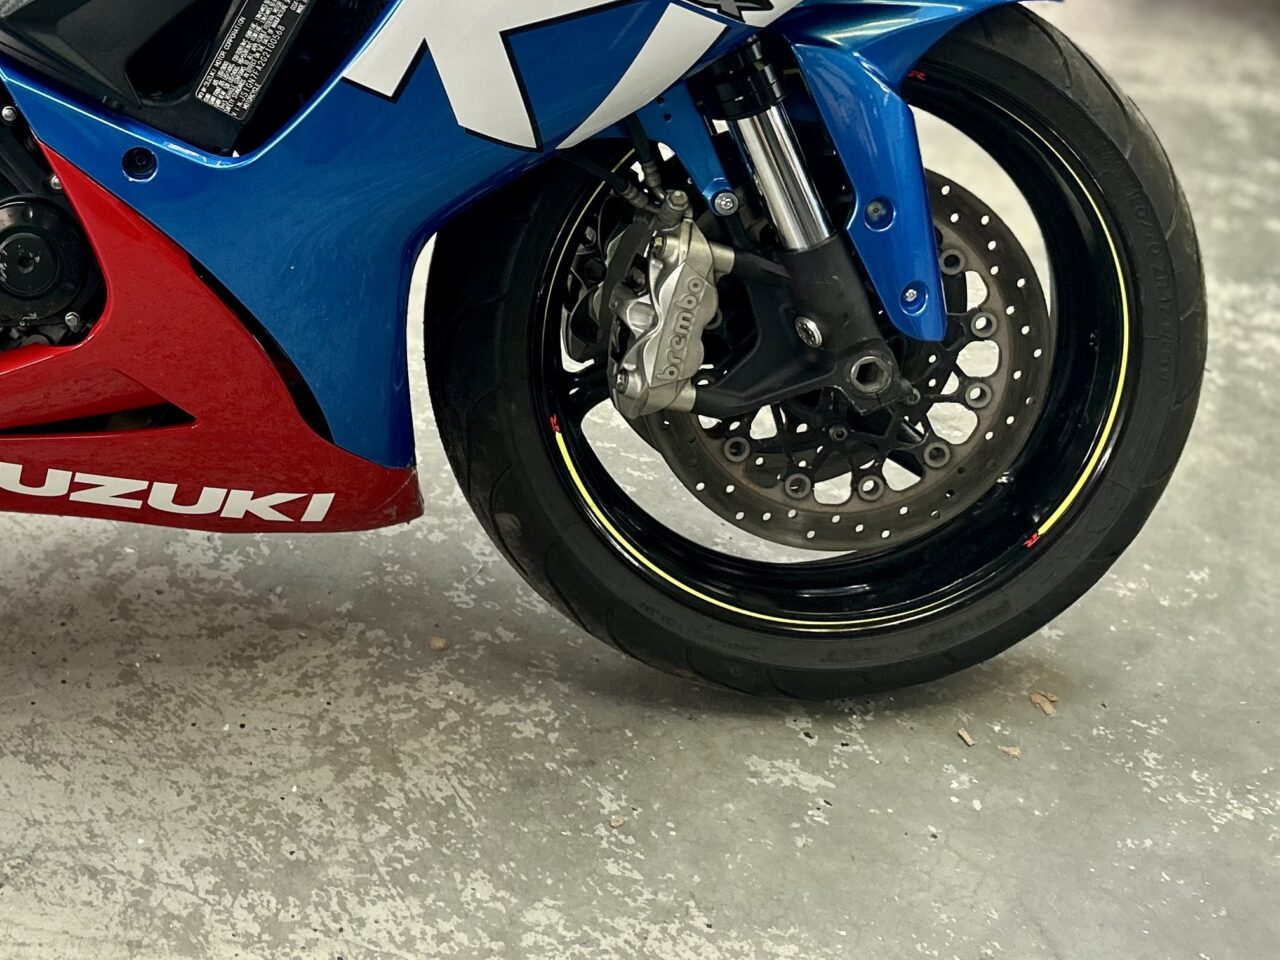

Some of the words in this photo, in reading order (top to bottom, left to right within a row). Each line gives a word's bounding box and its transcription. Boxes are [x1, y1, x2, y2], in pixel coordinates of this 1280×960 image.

[214, 50, 227, 67] MOTOR
[223, 16, 246, 50] CORPORATION
[656, 277, 706, 380] brembo
